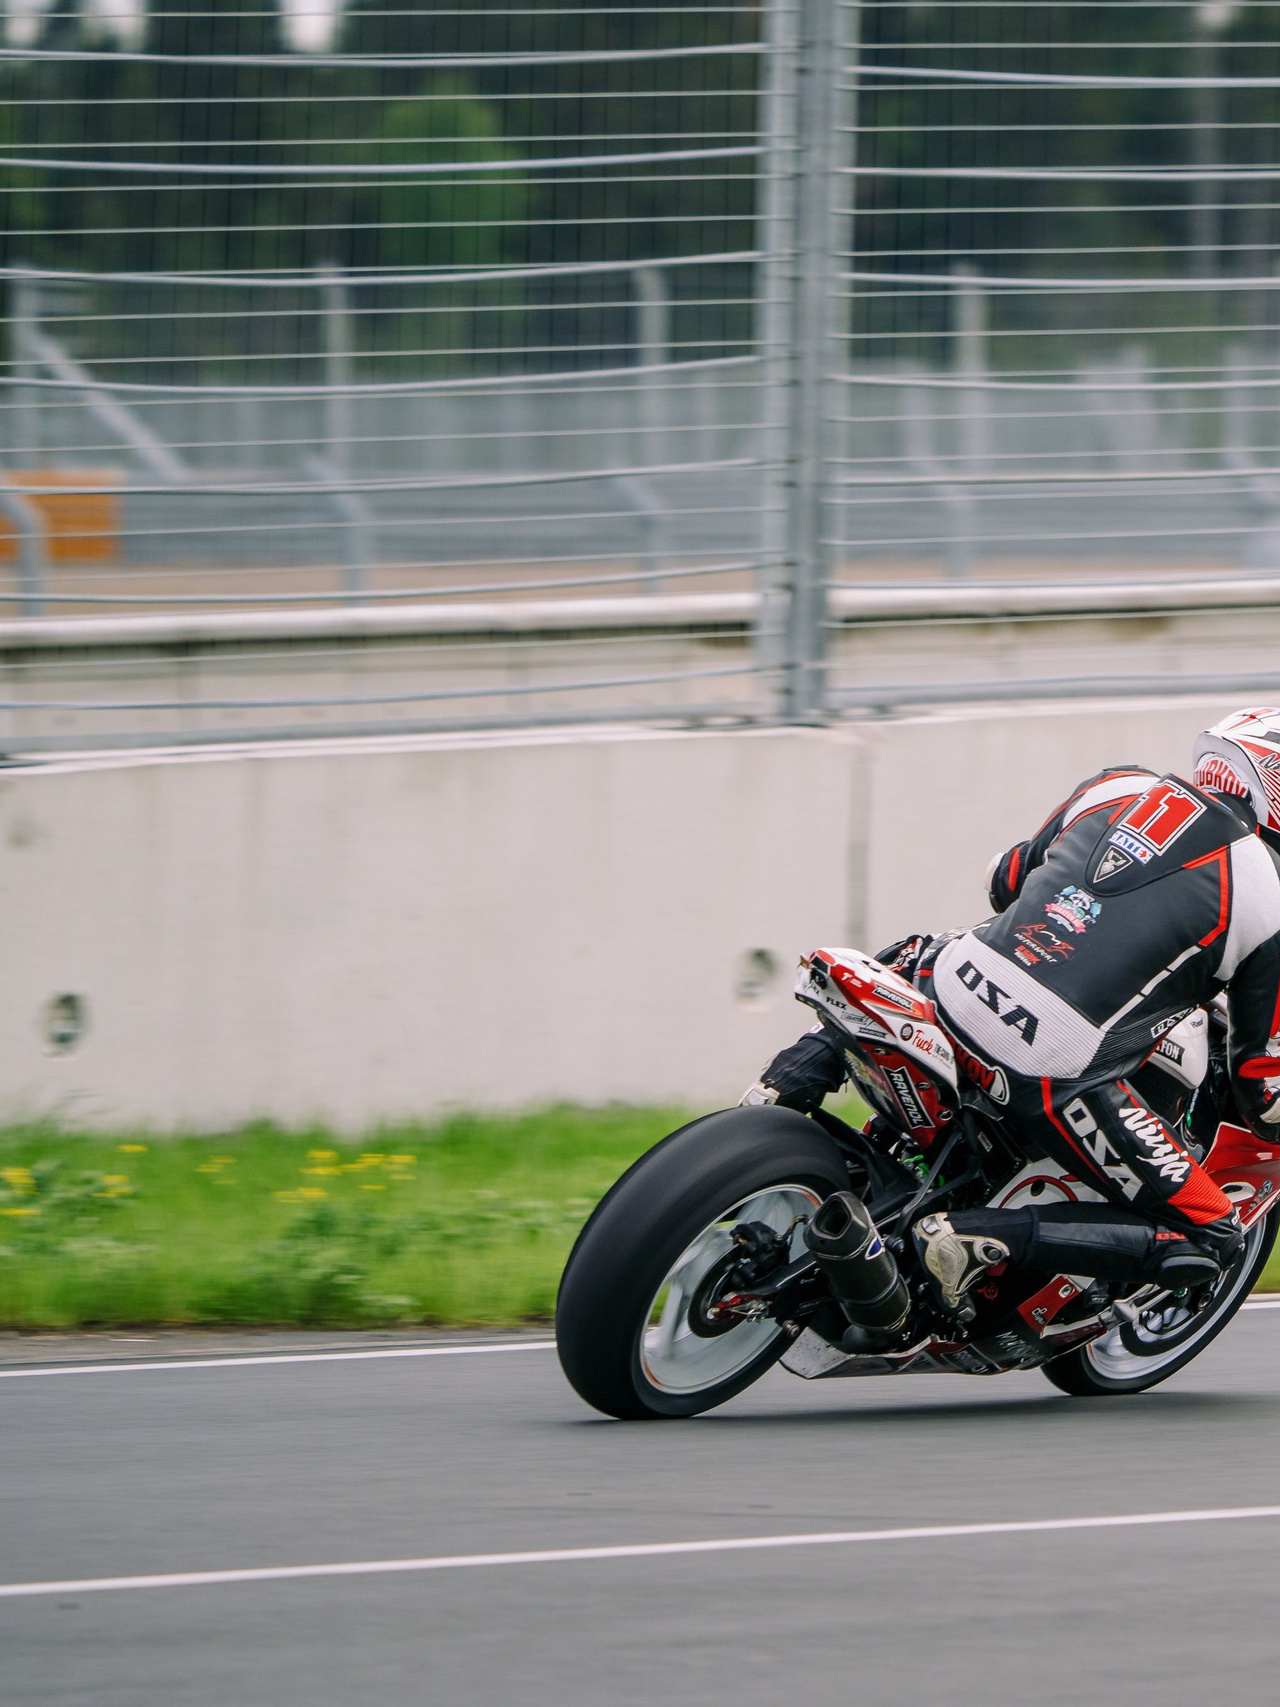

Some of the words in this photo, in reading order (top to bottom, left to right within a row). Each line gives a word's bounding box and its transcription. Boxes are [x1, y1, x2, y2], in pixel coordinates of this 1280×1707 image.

[1116, 779, 1207, 856] 11
[826, 997, 847, 1011] FLEX
[956, 960, 1039, 1047] OSA
[912, 1029, 934, 1056] Fuck
[891, 1073, 927, 1125] RAVENOL
[1063, 1098, 1145, 1202] OSA
[1118, 1107, 1192, 1183] Ninja
